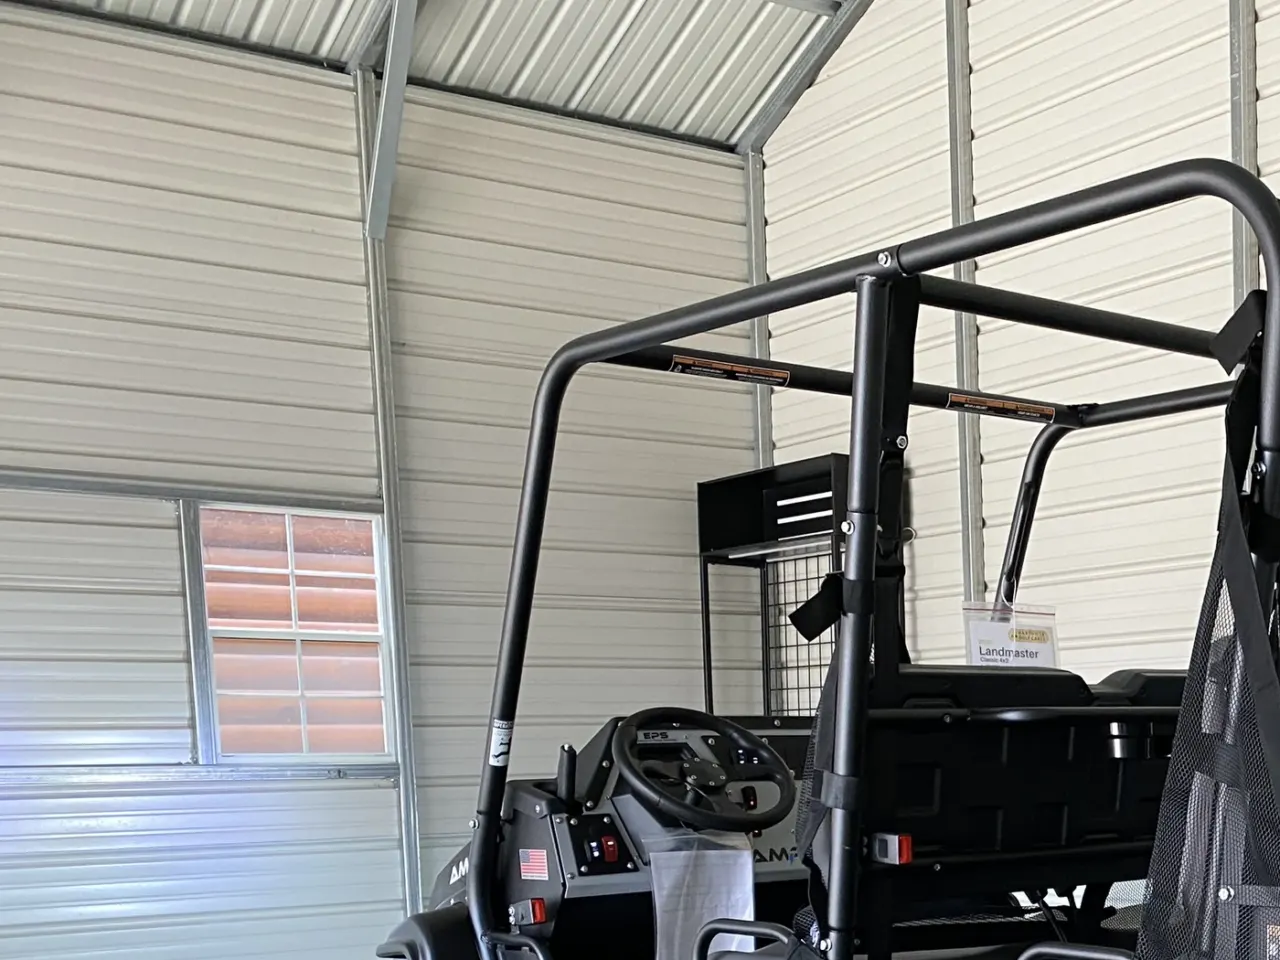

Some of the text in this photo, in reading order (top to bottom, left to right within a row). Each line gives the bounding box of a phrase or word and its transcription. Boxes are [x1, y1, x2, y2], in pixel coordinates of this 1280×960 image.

[979, 646, 1039, 660] Landmaster
[643, 731, 669, 740] EPS
[449, 857, 469, 885] AM
